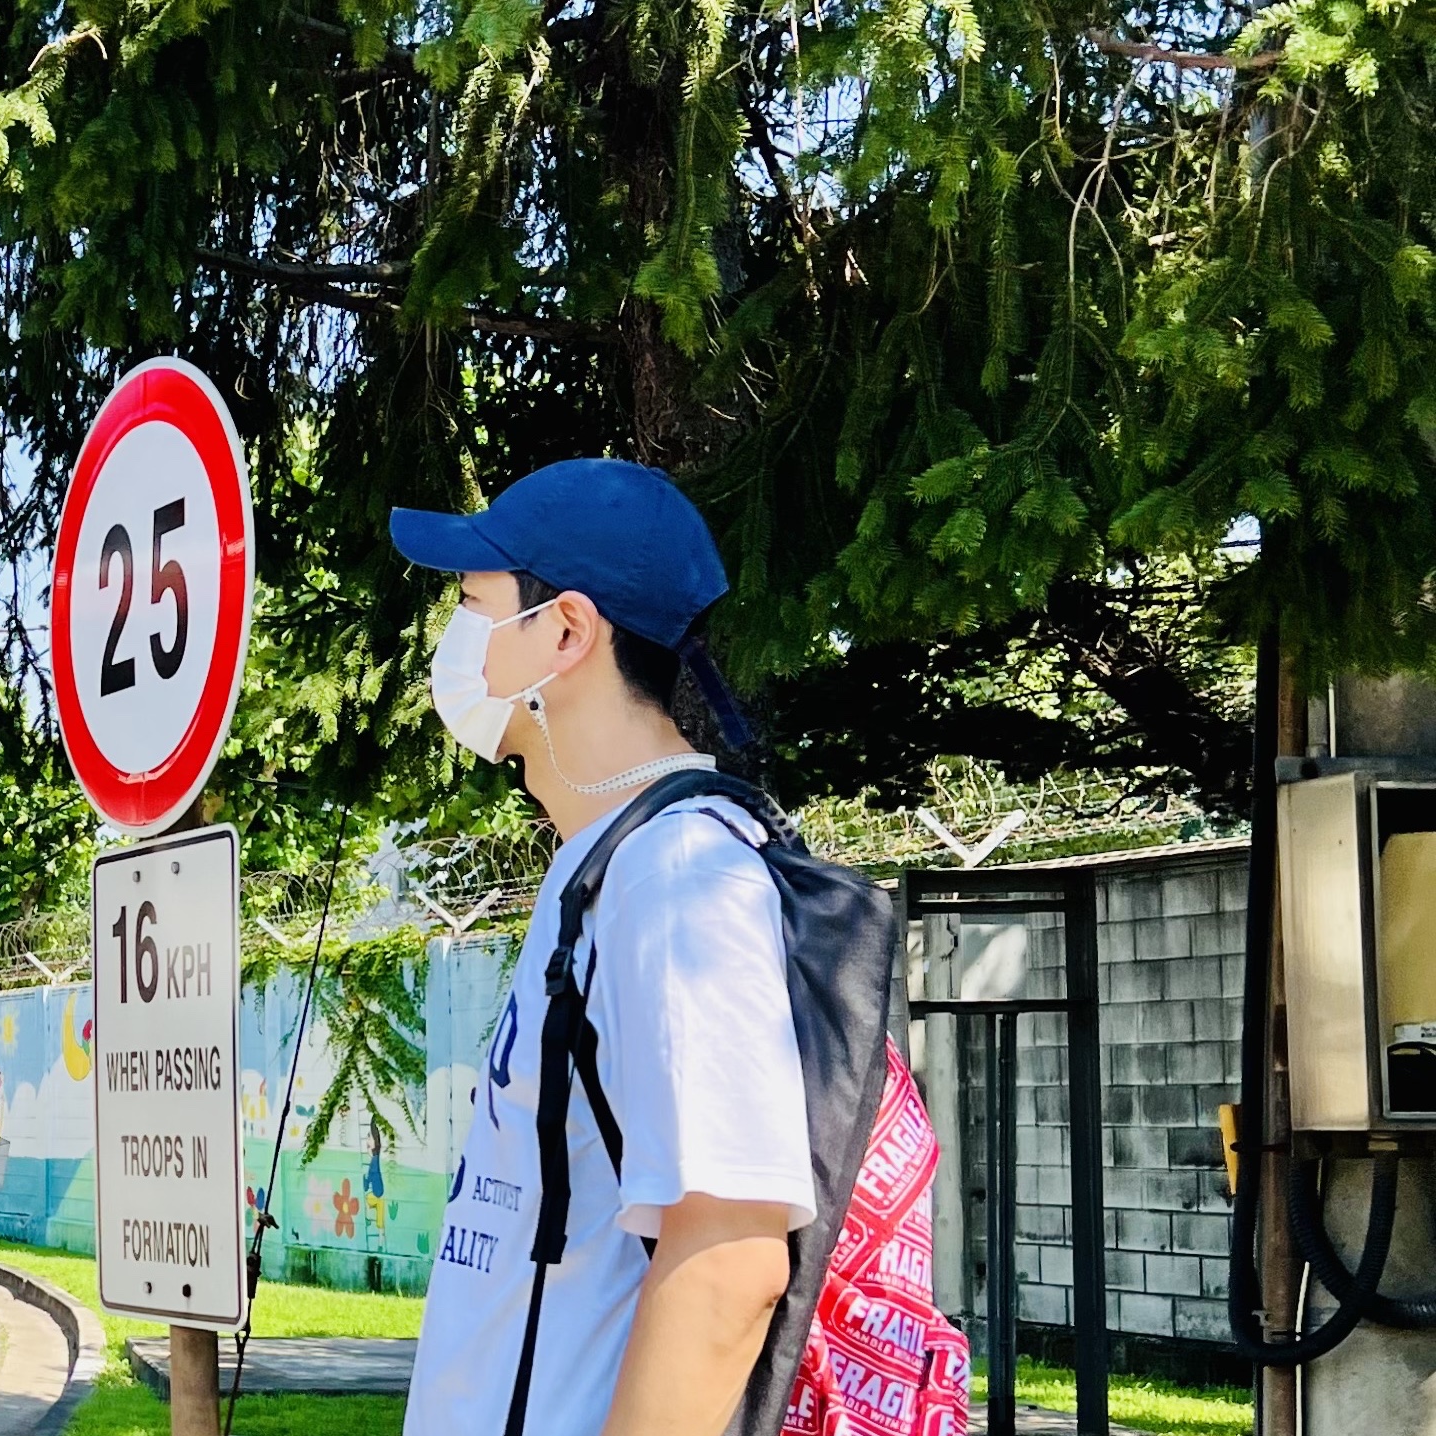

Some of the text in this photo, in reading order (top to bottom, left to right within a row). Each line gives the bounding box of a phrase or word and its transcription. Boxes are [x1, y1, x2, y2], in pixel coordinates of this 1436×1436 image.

[99, 497, 189, 698] 25
[112, 901, 212, 1005] 16 KPH
[106, 1046, 221, 1092] WHEN PASSING
[121, 1135, 208, 1179] TROOPS IN
[856, 1097, 927, 1199] FRAGILE
[122, 1218, 211, 1269] FORMATION
[440, 1225, 499, 1274] ALITY
